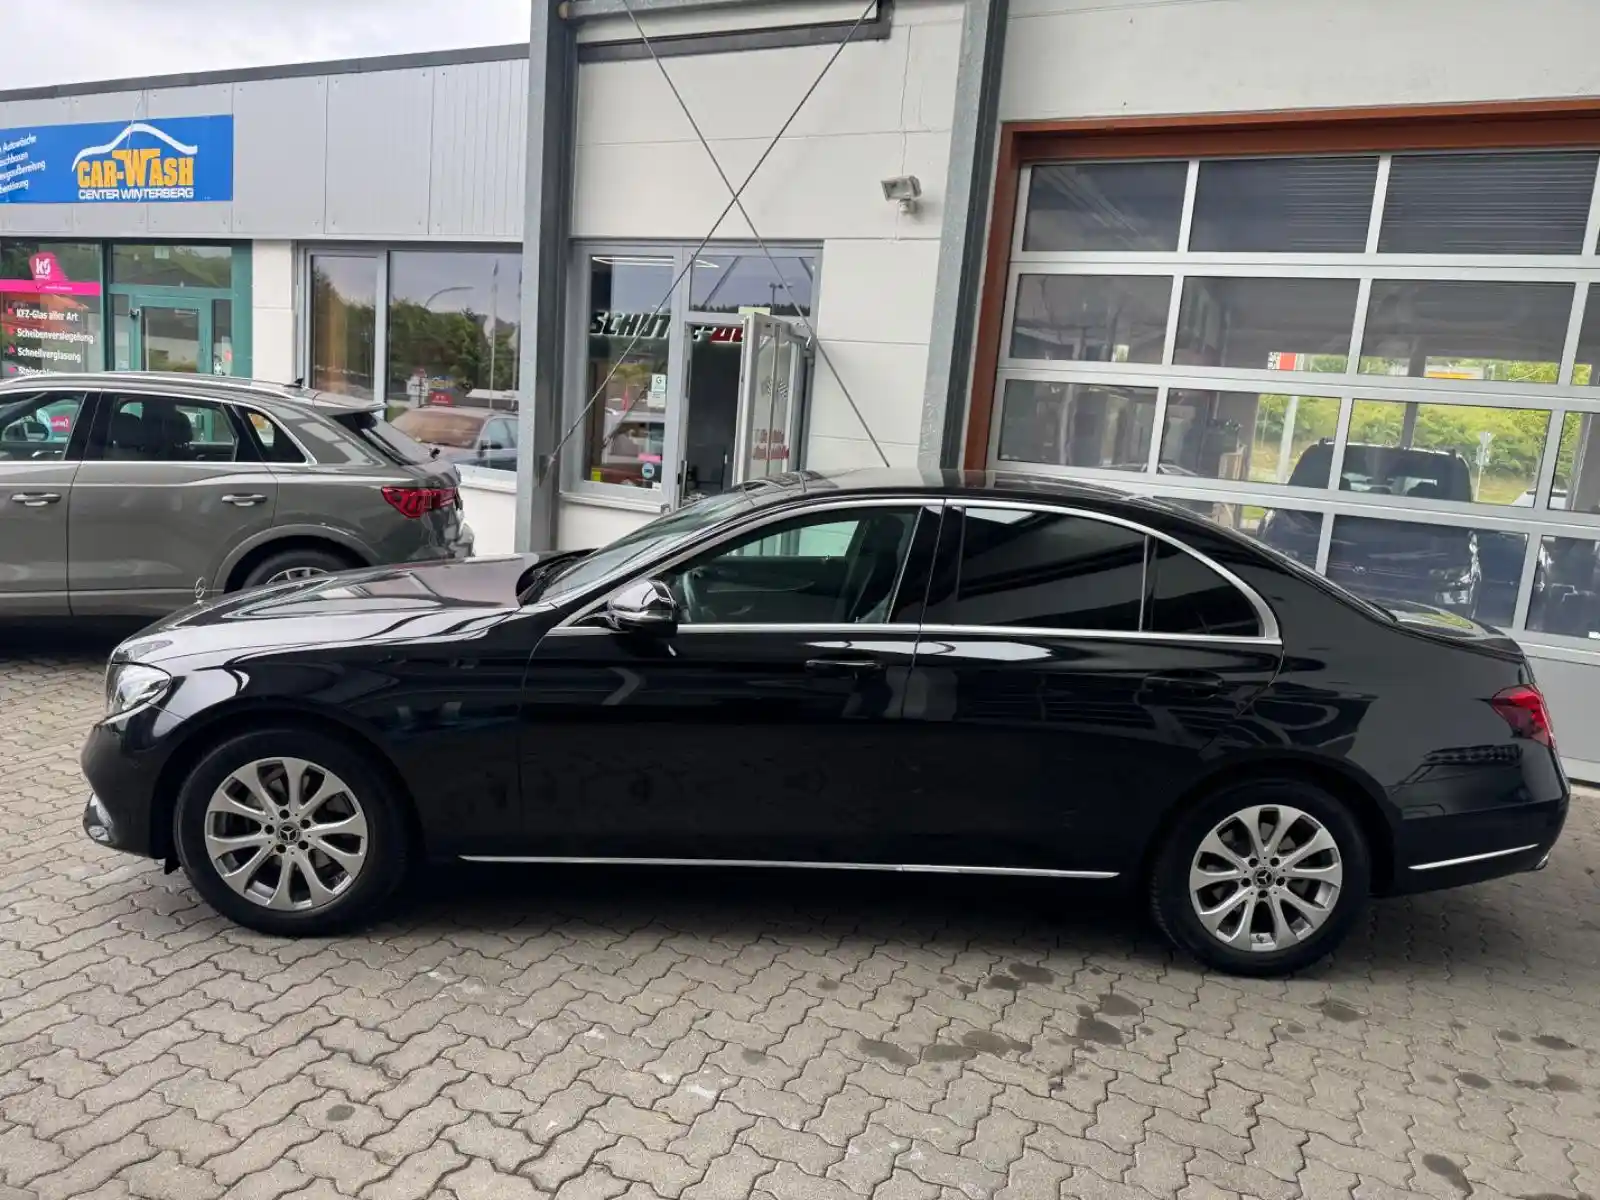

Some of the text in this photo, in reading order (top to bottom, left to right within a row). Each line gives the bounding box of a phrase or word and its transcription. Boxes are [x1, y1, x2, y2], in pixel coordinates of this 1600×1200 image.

[77, 148, 194, 188] CAR-WASH
[78, 187, 194, 200] CENTER WINTERBERG
[16, 308, 48, 320] KFZ-Glas
[66, 311, 79, 322] Art
[16, 328, 94, 344] Scheibenversiegelung
[17, 347, 82, 363] Schnellverglasung
